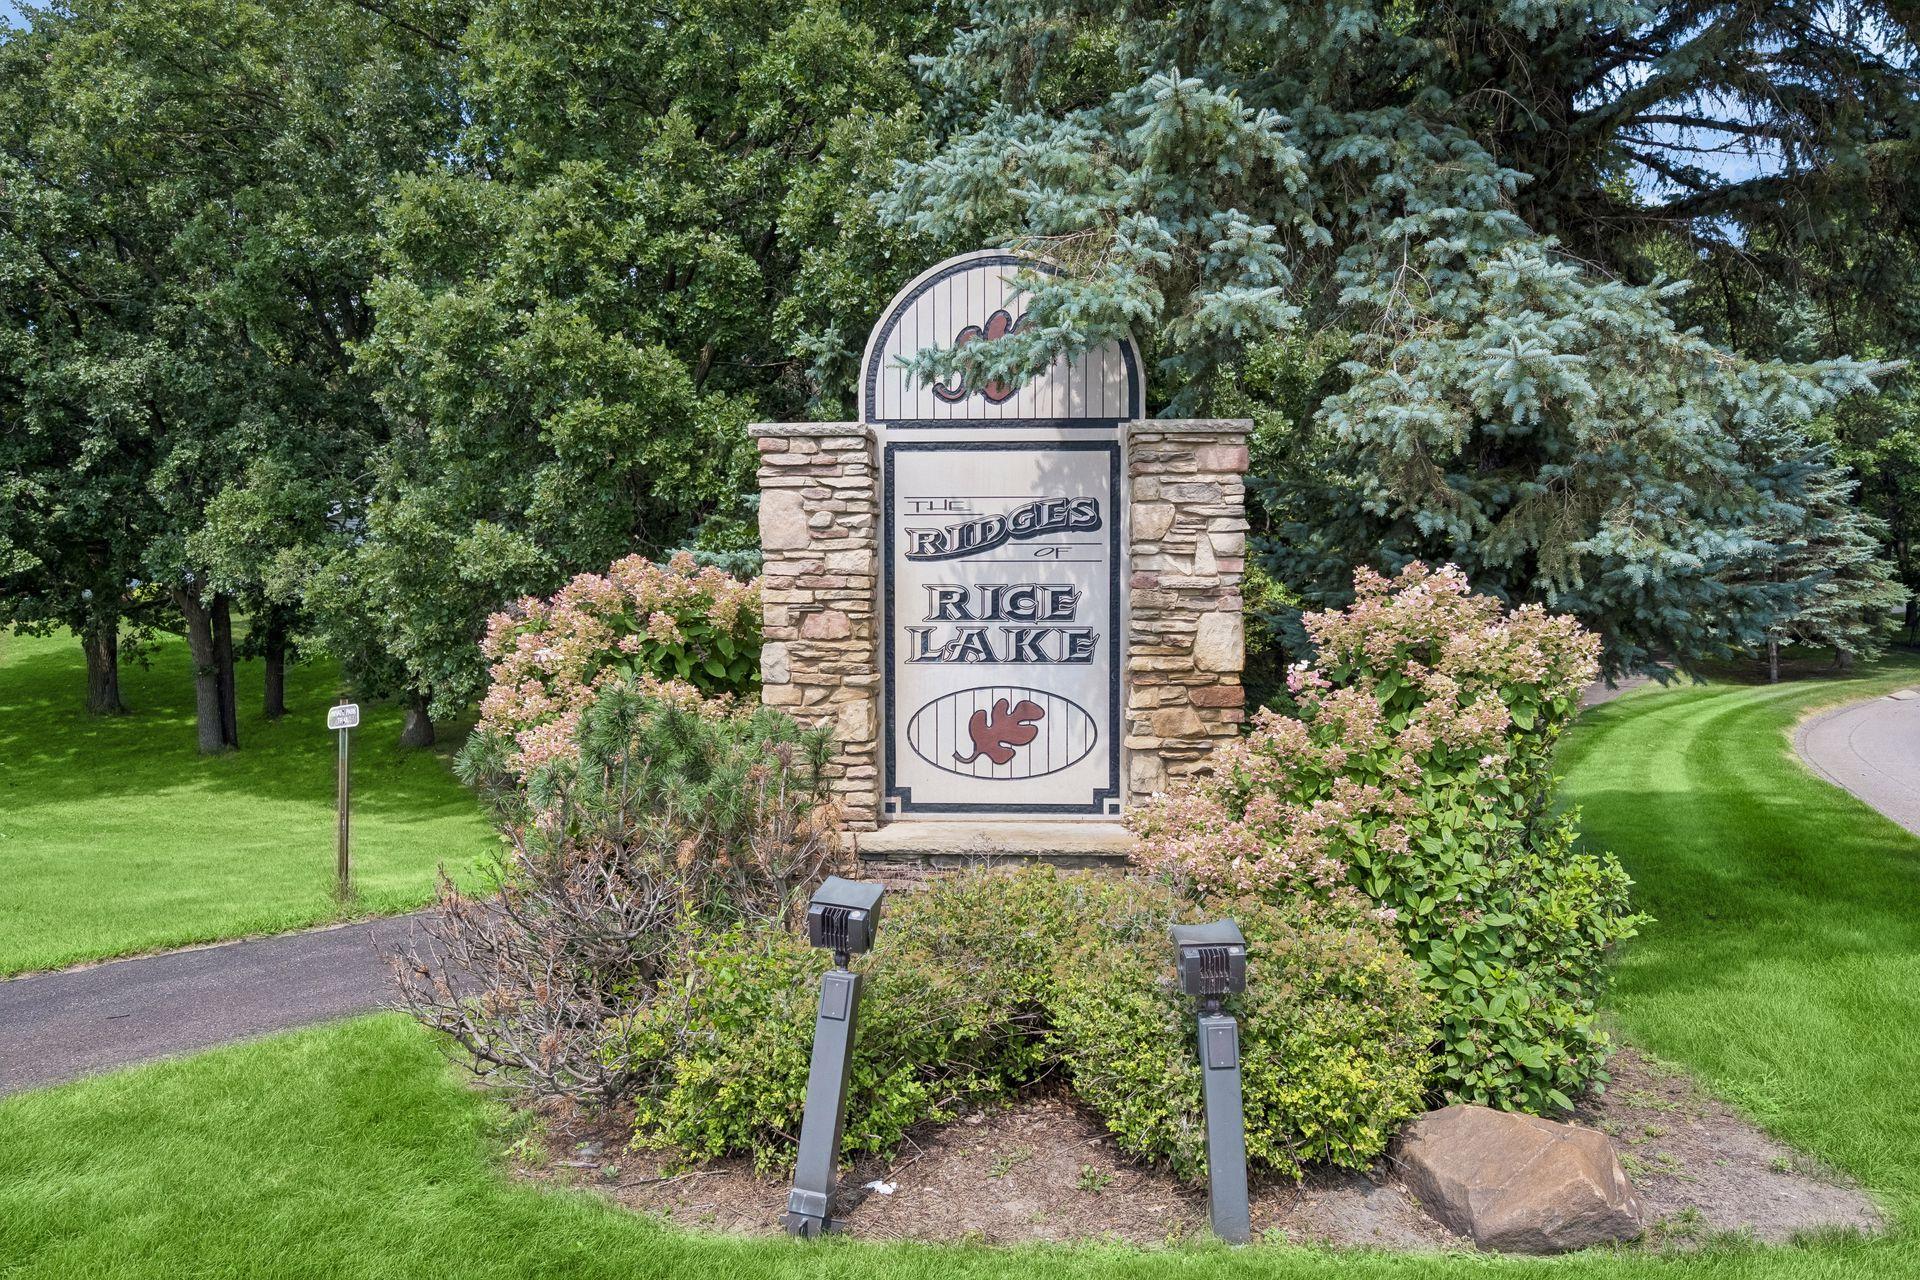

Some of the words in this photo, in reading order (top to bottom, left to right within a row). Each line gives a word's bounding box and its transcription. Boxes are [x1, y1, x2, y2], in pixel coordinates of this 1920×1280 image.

[907, 499, 972, 513] THE
[904, 496, 1103, 561] RIDGES
[1033, 546, 1073, 559] OF
[921, 583, 1083, 625] RICE
[904, 626, 1101, 665] LAKE
